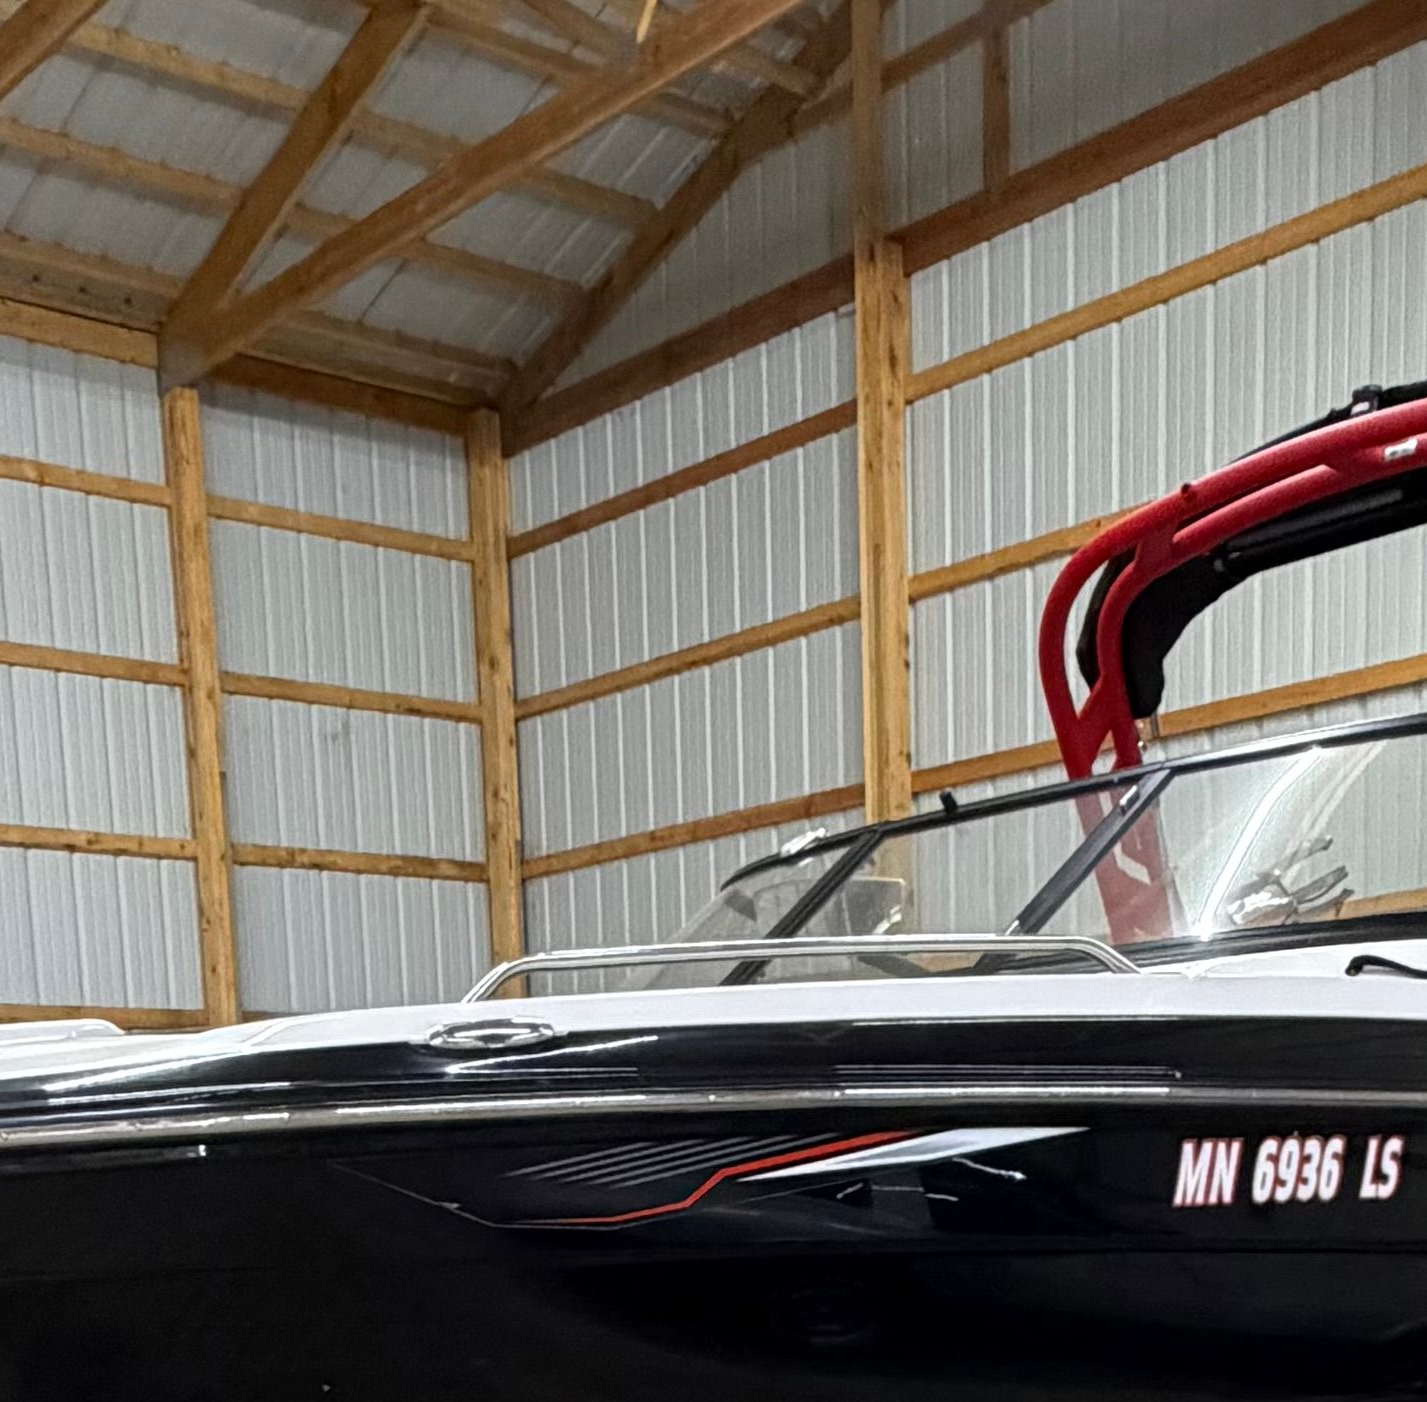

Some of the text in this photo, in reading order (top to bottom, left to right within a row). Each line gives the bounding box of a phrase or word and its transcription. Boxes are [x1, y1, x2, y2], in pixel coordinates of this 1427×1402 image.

[1172, 1134, 1404, 1207] MN 6936 LS
